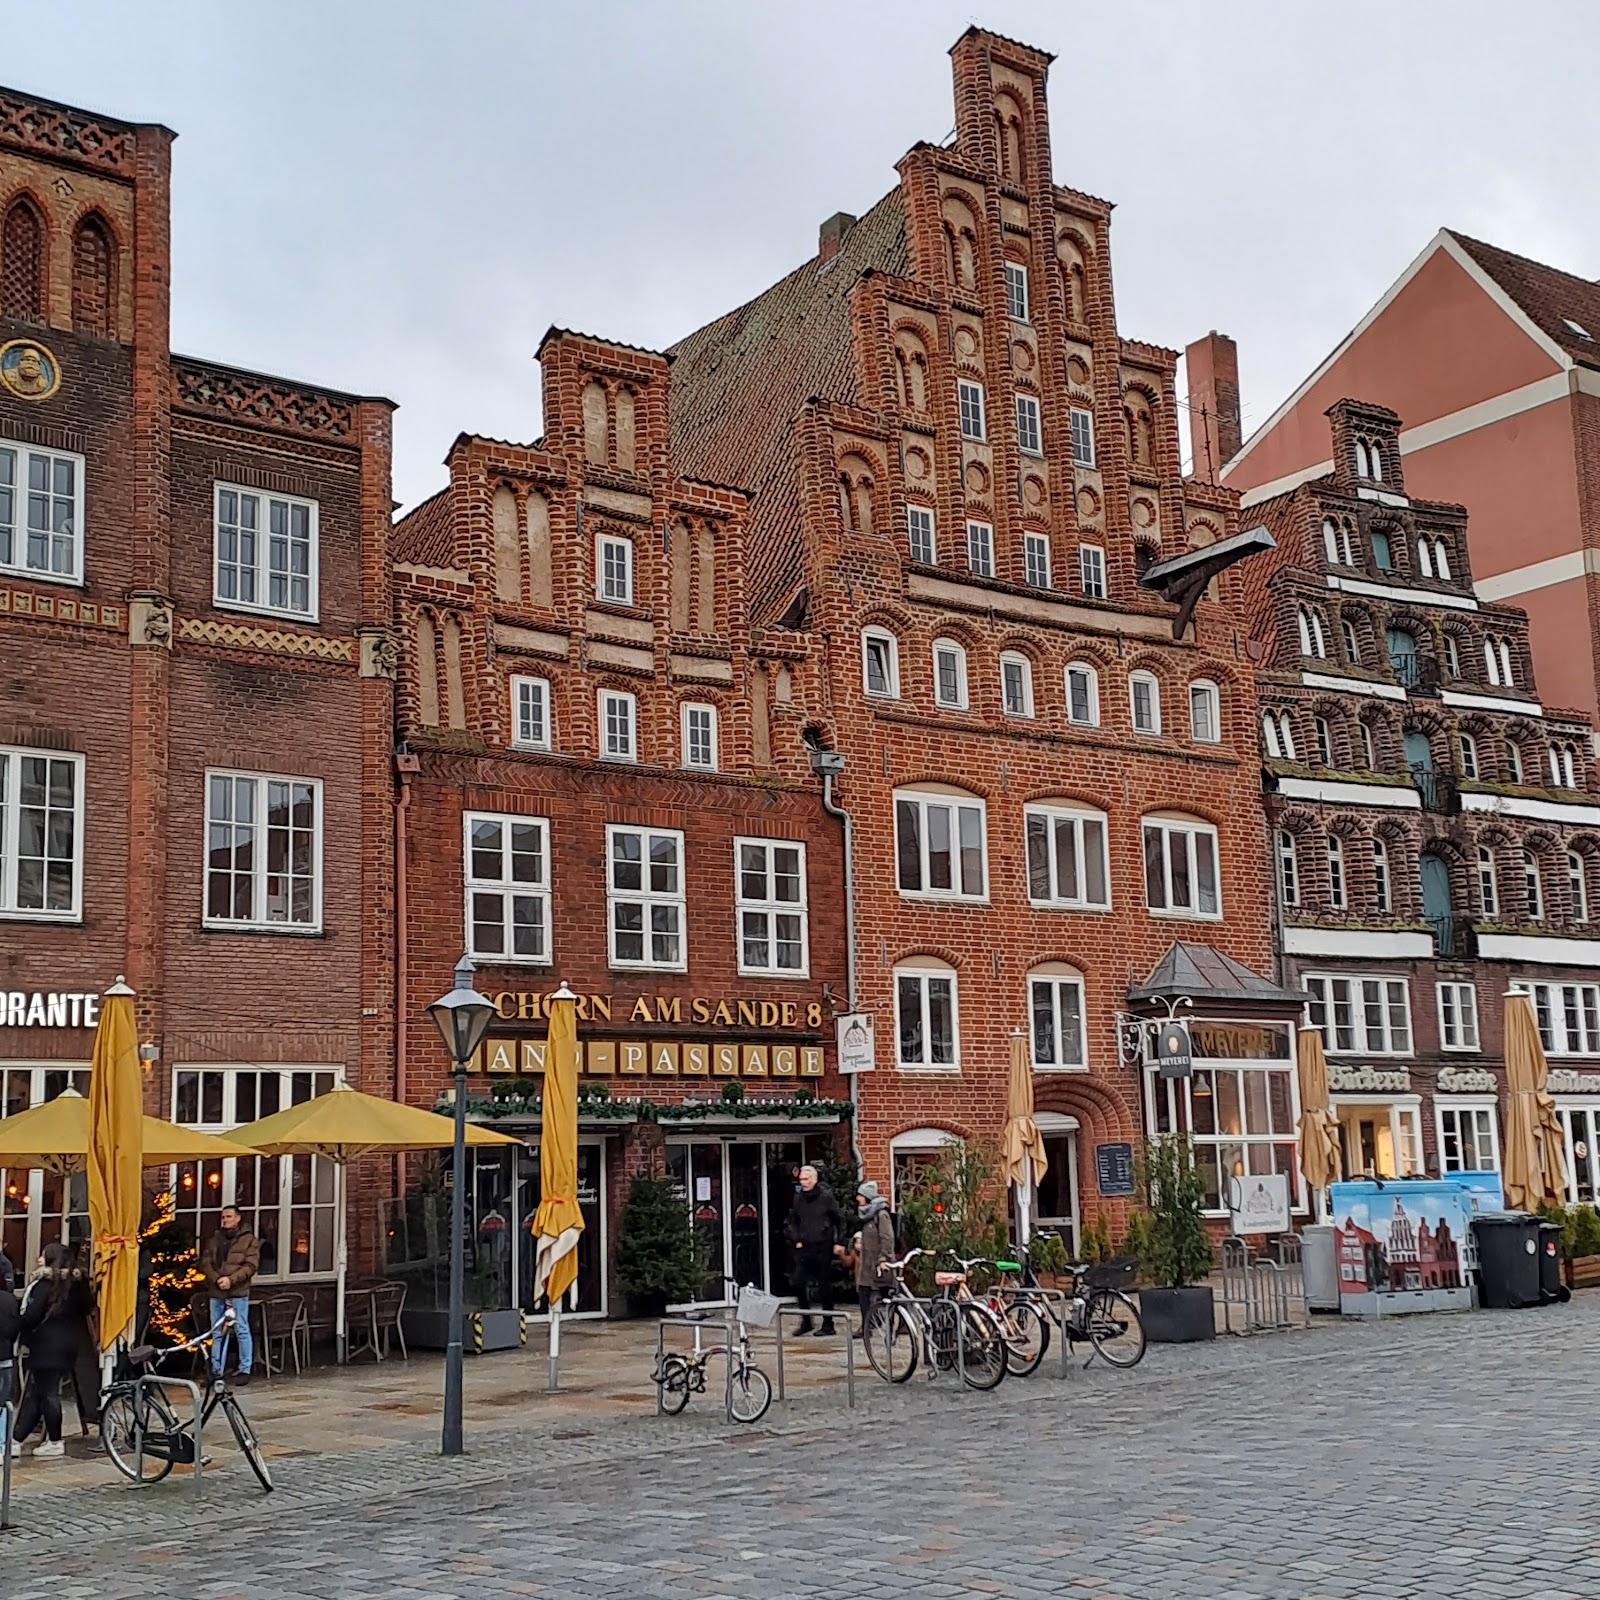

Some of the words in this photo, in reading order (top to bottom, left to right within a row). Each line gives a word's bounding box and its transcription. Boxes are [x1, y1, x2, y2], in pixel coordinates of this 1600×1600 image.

[629, 997, 682, 1023] AM
[692, 997, 798, 1027] SANDE
[806, 1002, 822, 1027] 8
